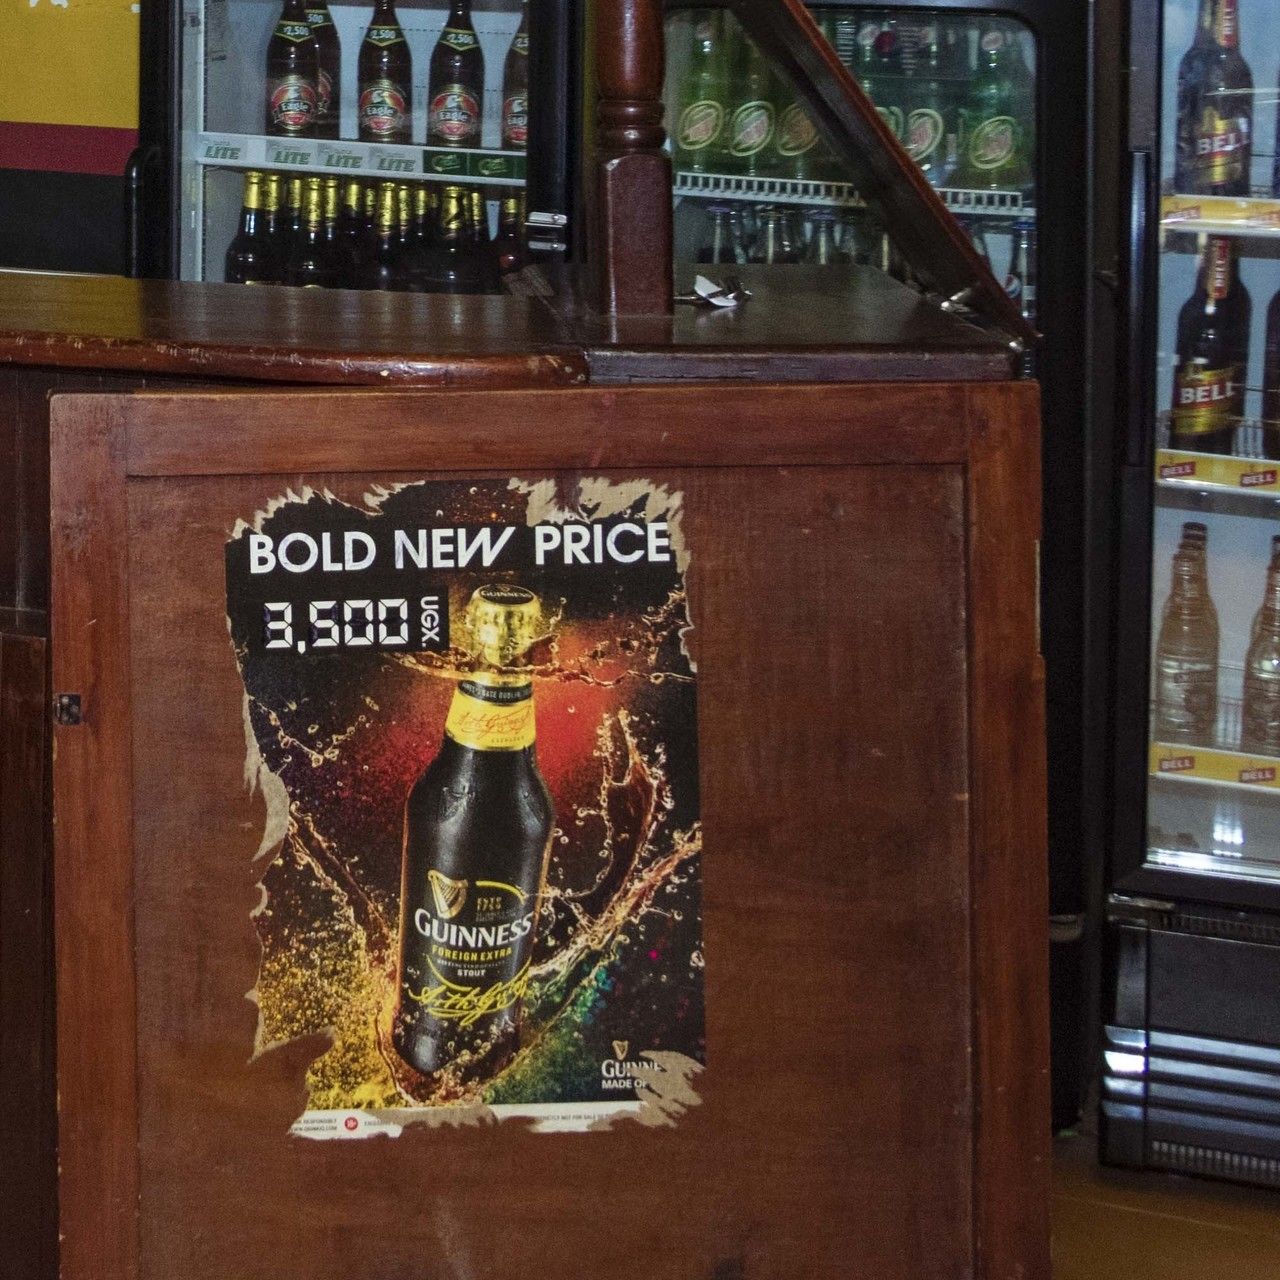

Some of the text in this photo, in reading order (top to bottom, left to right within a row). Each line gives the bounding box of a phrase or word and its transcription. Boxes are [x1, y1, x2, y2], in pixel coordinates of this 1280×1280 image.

[326, 154, 362, 169] LITE
[1179, 382, 1236, 404] BELL
[248, 521, 671, 574] BOLD NEW PRICE
[479, 587, 535, 603] GUINNESS
[264, 598, 409, 655] 3,500
[414, 908, 534, 948] GUINNESS
[432, 944, 512, 961] FOREIGN EXTRA
[457, 969, 486, 977] STOUT
[601, 1079, 629, 1090] MADE
